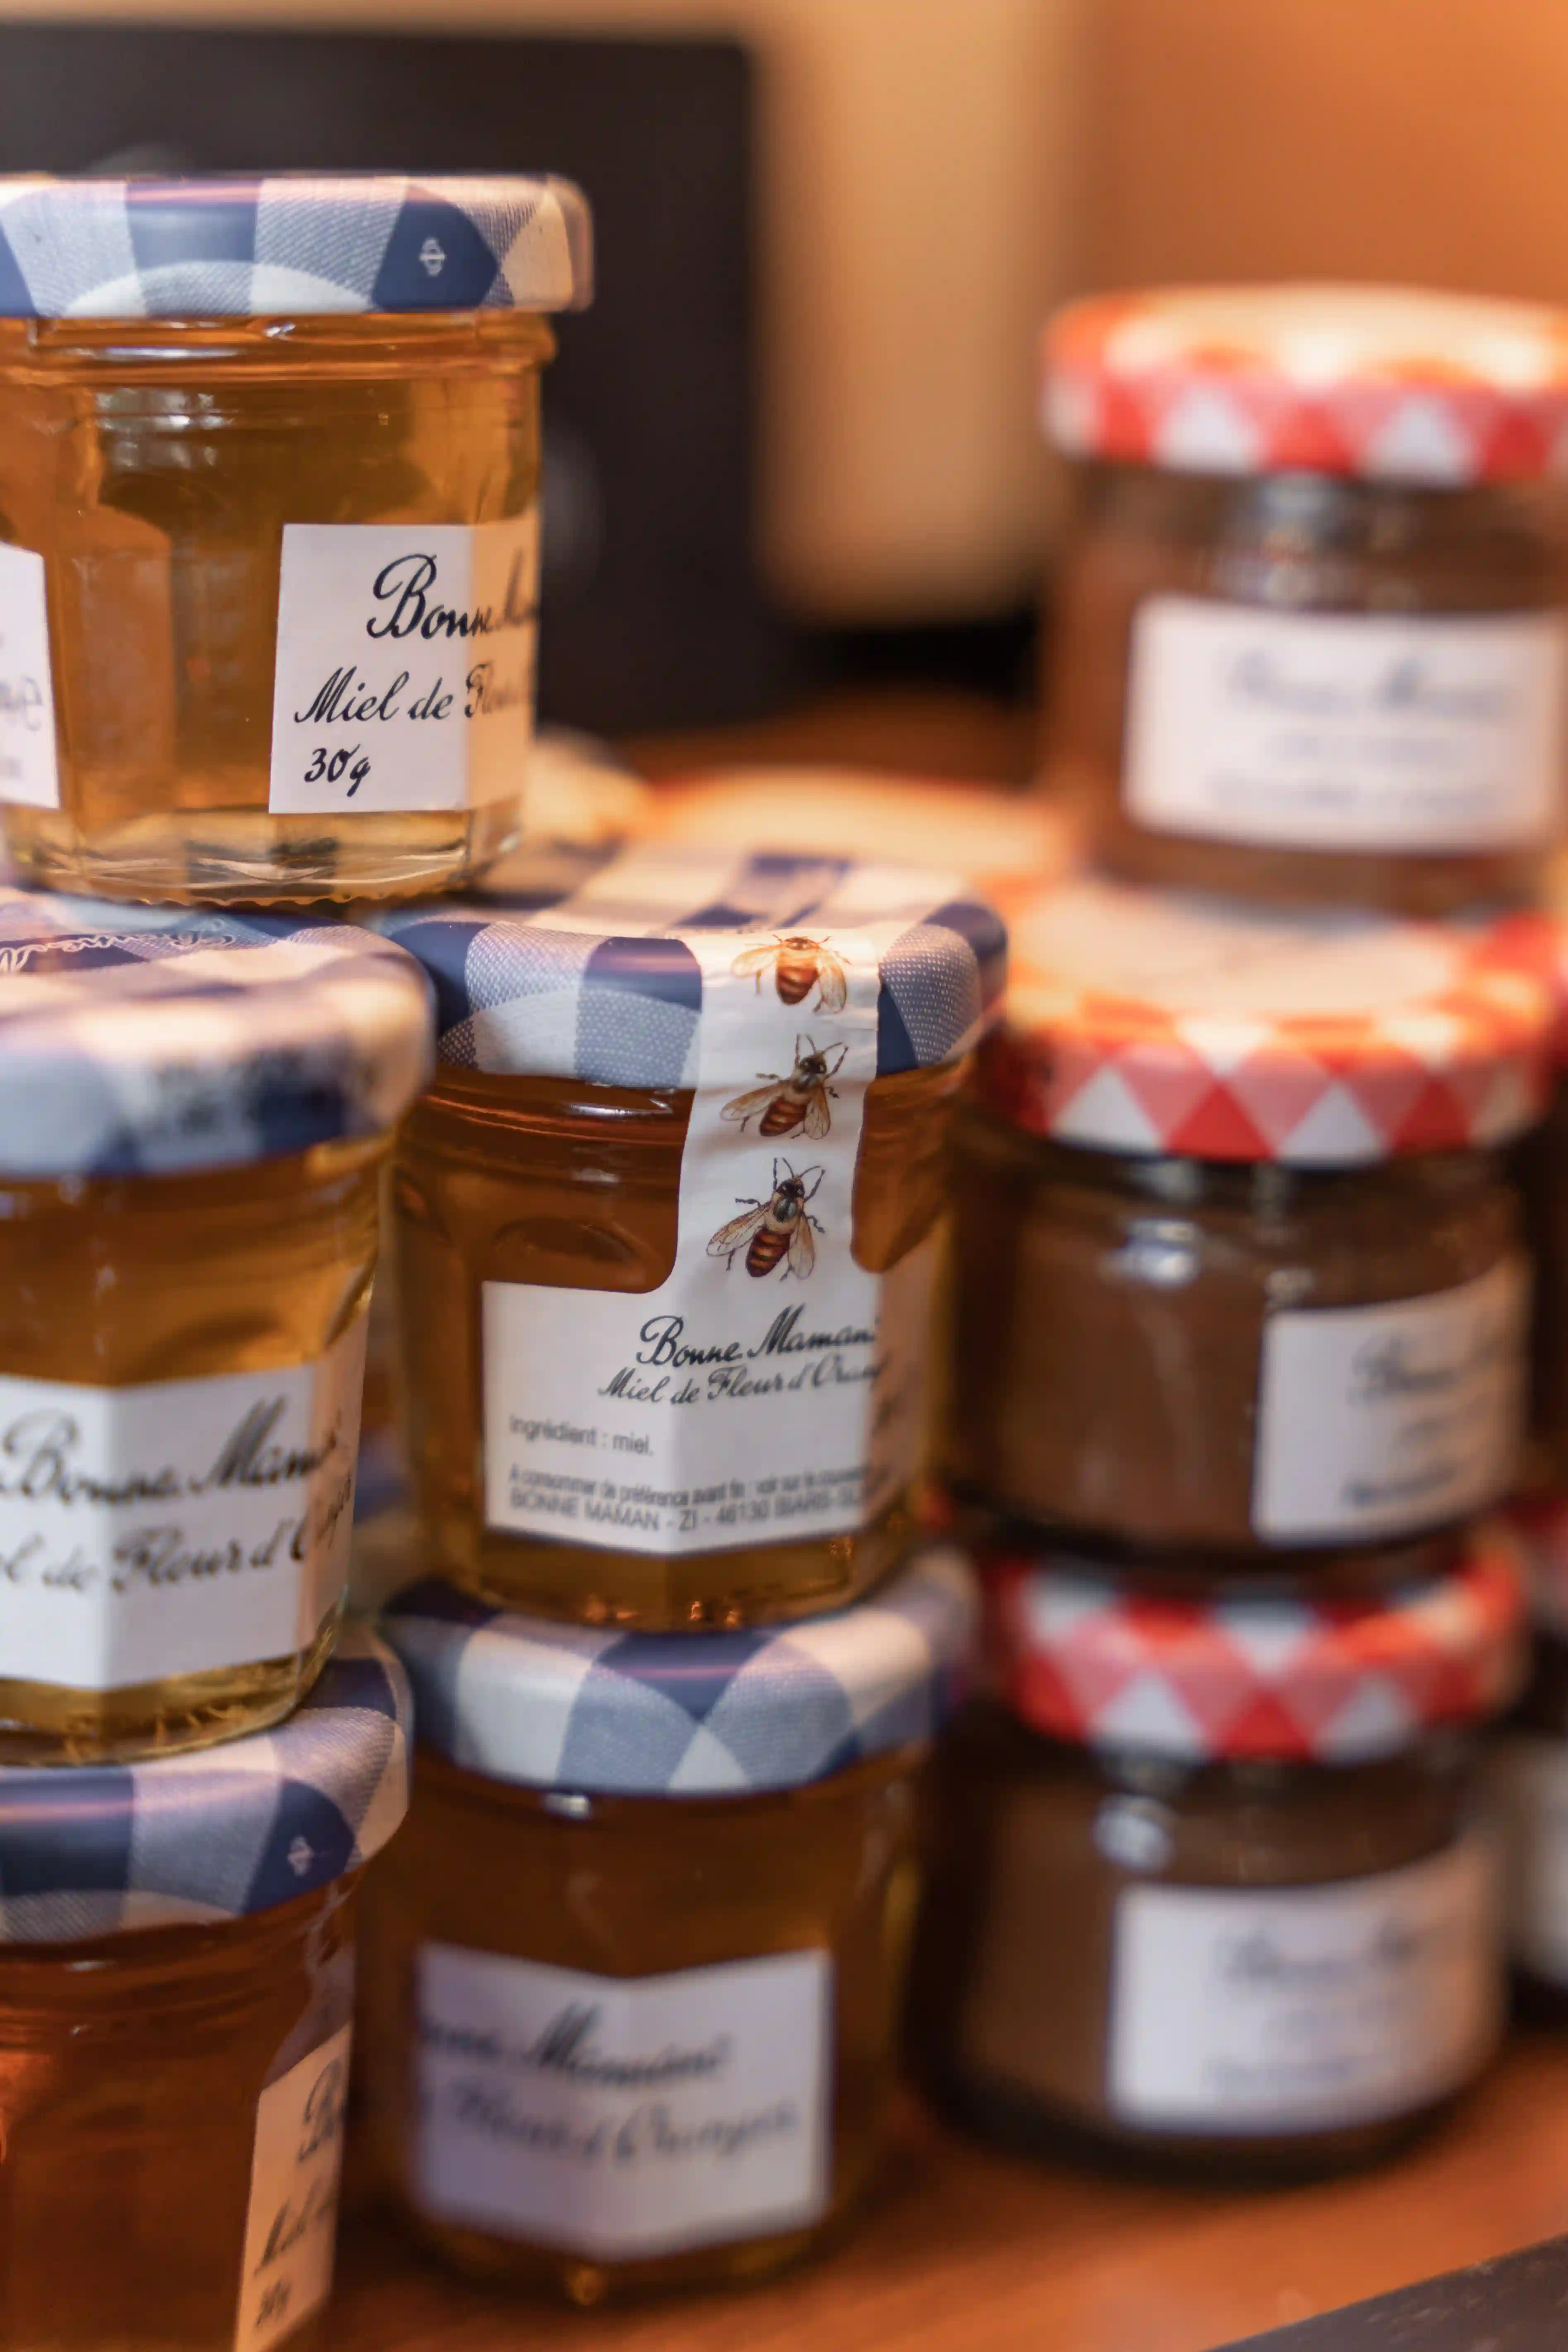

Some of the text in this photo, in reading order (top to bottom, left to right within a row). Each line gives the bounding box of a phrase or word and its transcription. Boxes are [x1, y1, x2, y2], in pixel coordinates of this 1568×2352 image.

[367, 553, 493, 640] Bonne
[293, 665, 410, 723] Miel
[407, 677, 454, 721] de
[304, 743, 371, 797] 30g
[636, 1303, 876, 1367] Bonne Maman
[597, 1366, 670, 1404] Miel
[669, 1378, 701, 1405] de
[706, 1363, 784, 1401] Fleur
[509, 1413, 597, 1446] Ingrédient
[612, 1431, 655, 1457] miel.
[509, 1487, 579, 1519] BONNE
[583, 1498, 660, 1532] MAMAN
